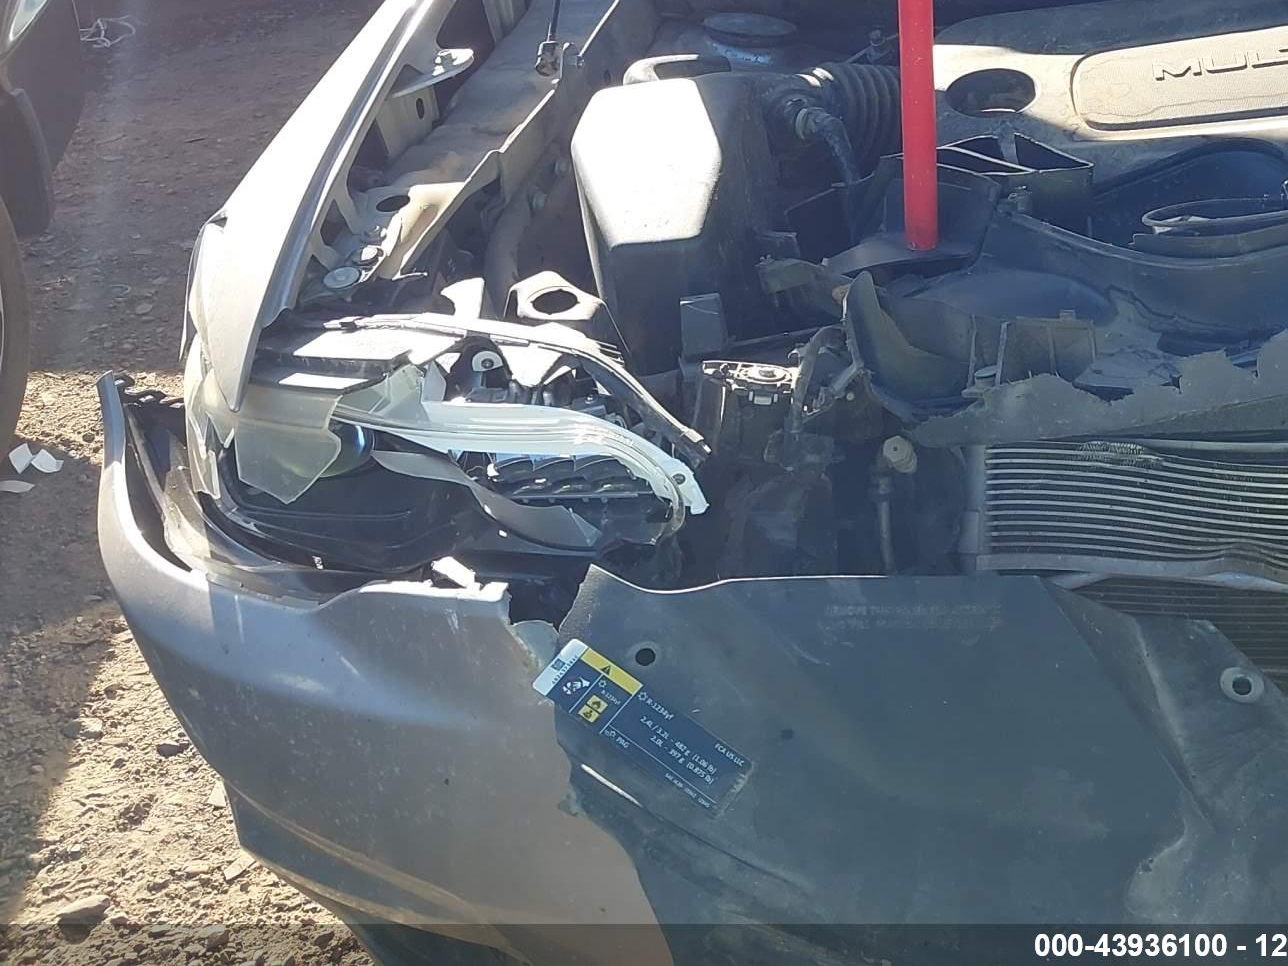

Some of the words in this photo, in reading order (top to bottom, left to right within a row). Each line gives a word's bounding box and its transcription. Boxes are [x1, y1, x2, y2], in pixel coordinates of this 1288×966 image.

[646, 698, 675, 721] R-1234yf
[615, 736, 631, 749] PAG
[650, 735, 664, 748] 2.0L
[669, 749, 682, 759] 397
[714, 743, 726, 754] FCA
[734, 756, 745, 767] LLC
